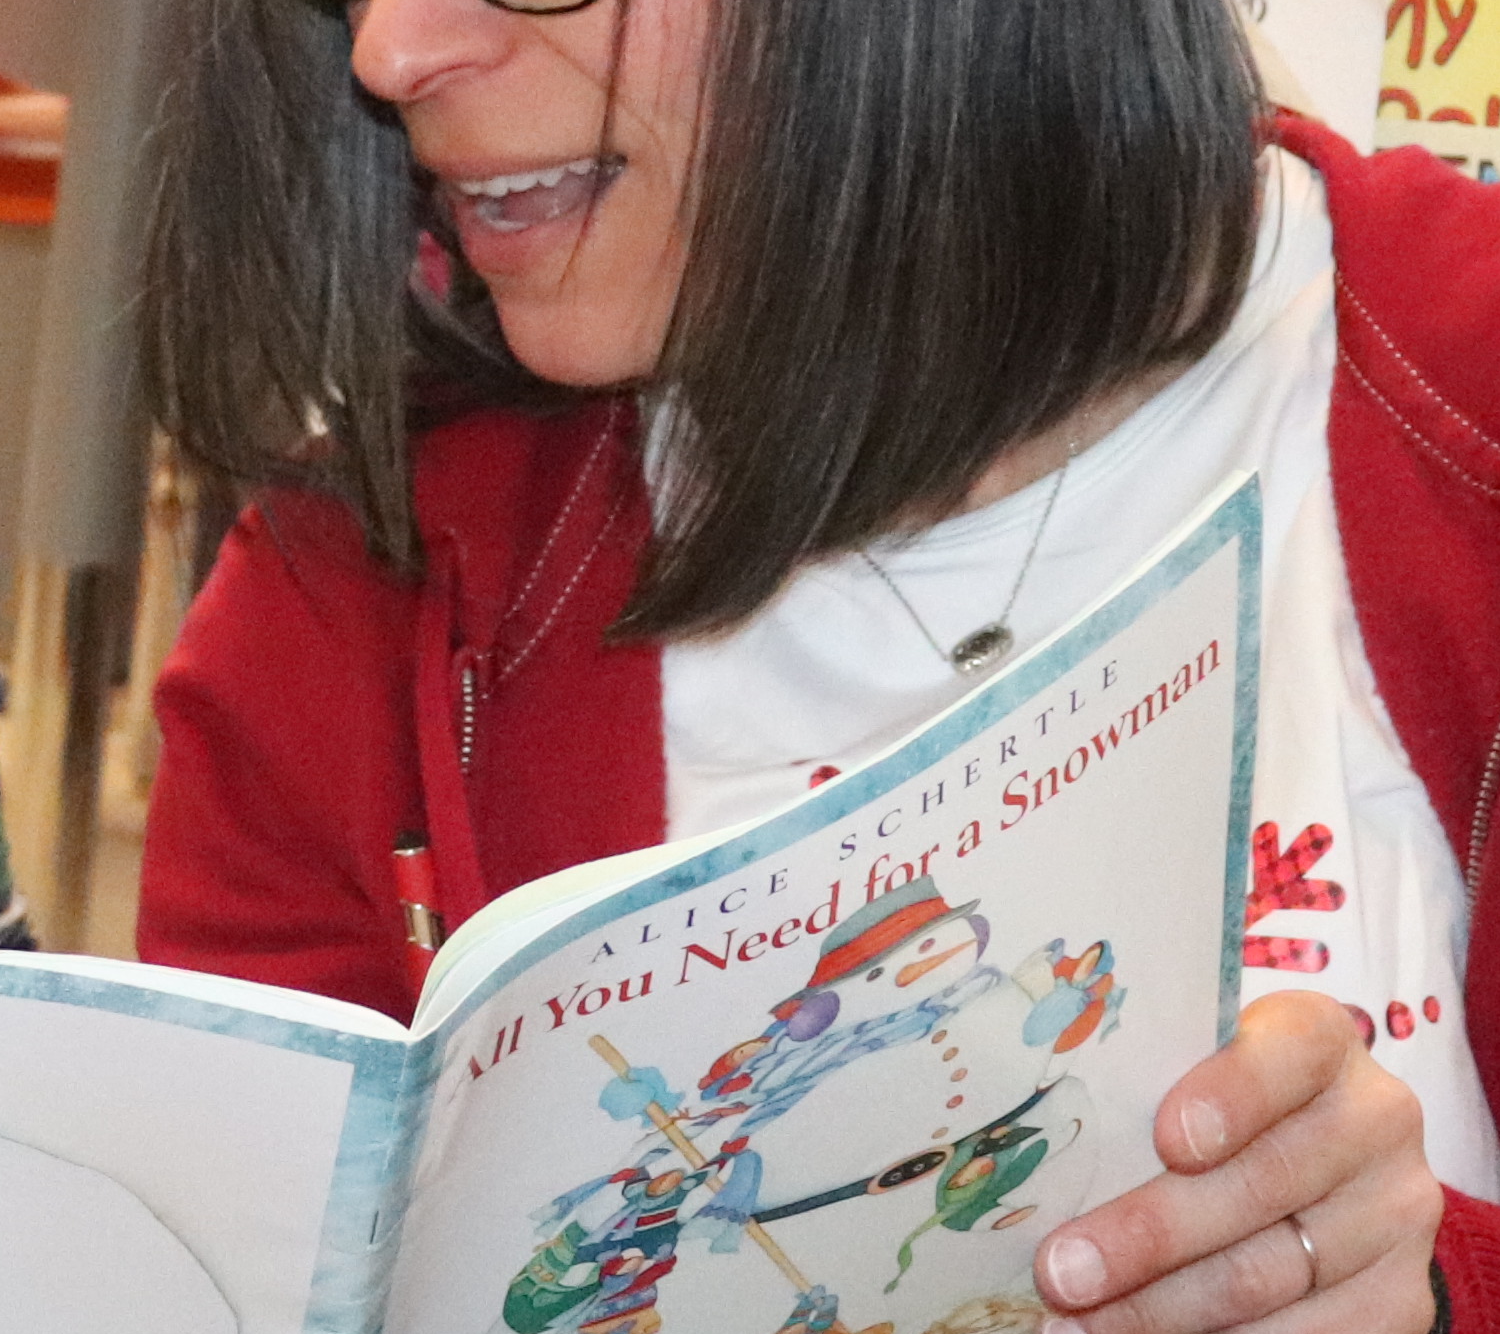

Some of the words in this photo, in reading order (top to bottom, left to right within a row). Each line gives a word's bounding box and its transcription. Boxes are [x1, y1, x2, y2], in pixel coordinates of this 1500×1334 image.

[449, 1015, 525, 1104] All
[541, 971, 653, 1032] You
[675, 880, 841, 986] Need
[864, 844, 940, 906] for
[956, 820, 983, 858] a
[1000, 637, 1222, 834] Snowman
[590, 868, 789, 964] ALICE
[838, 658, 1120, 864] SCHERTLE
